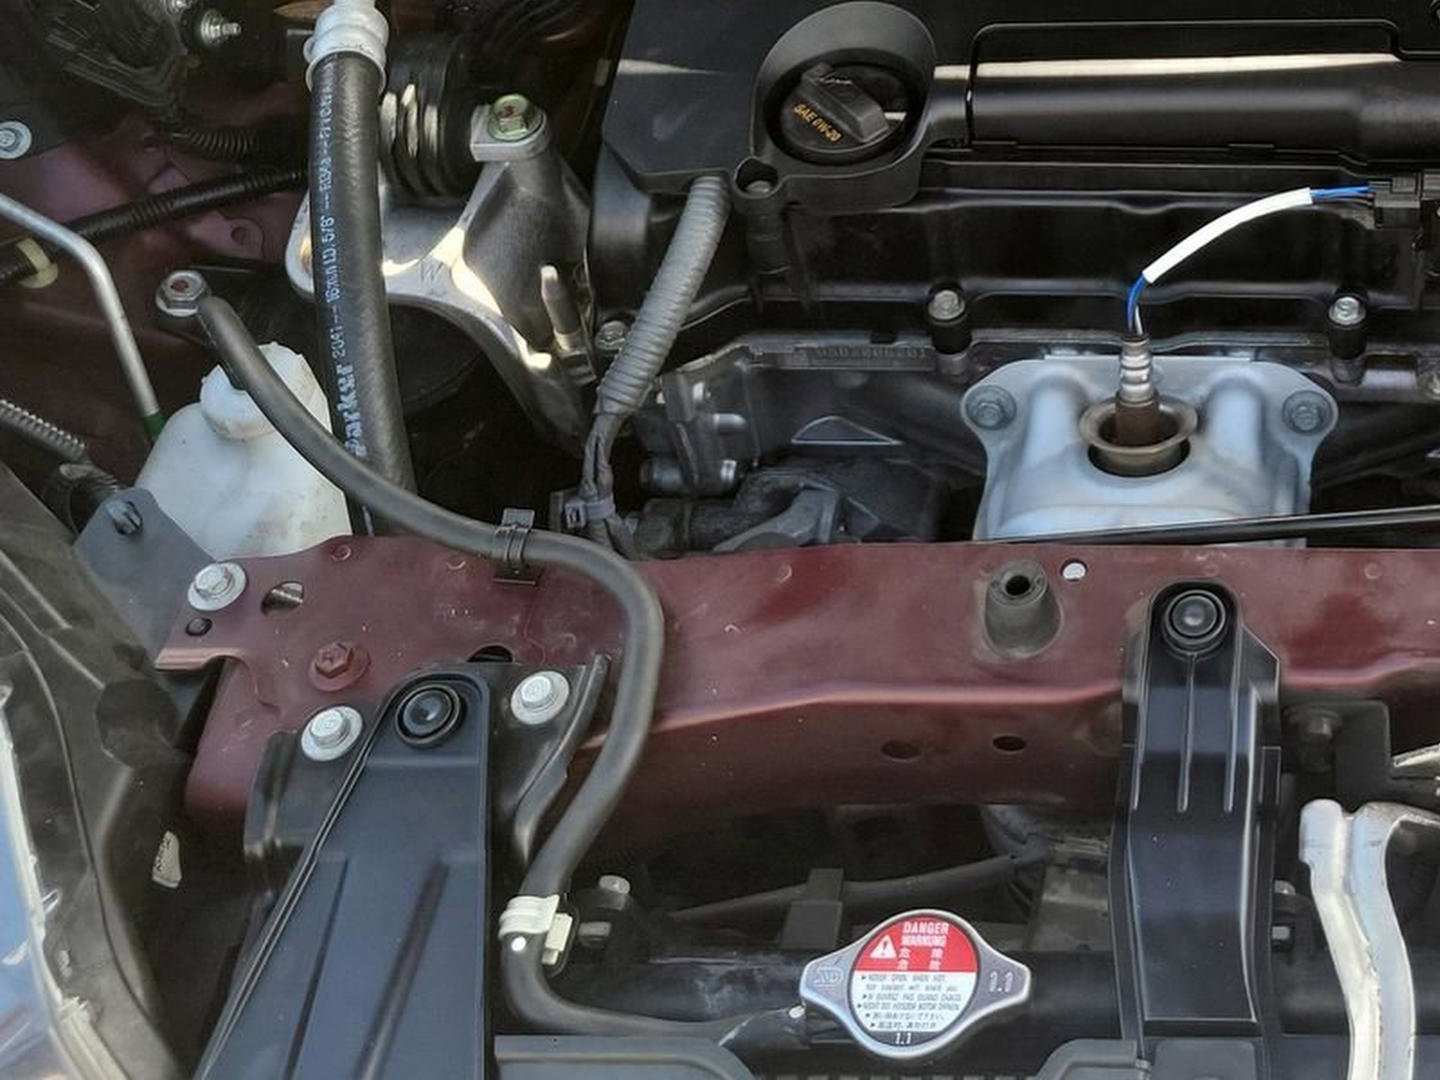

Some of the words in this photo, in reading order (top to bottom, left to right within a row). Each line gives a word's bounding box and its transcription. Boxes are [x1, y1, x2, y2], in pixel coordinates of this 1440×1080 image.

[793, 103, 816, 123] SAE
[903, 921, 950, 935] DANGER
[895, 1032, 912, 1045] 1.1
